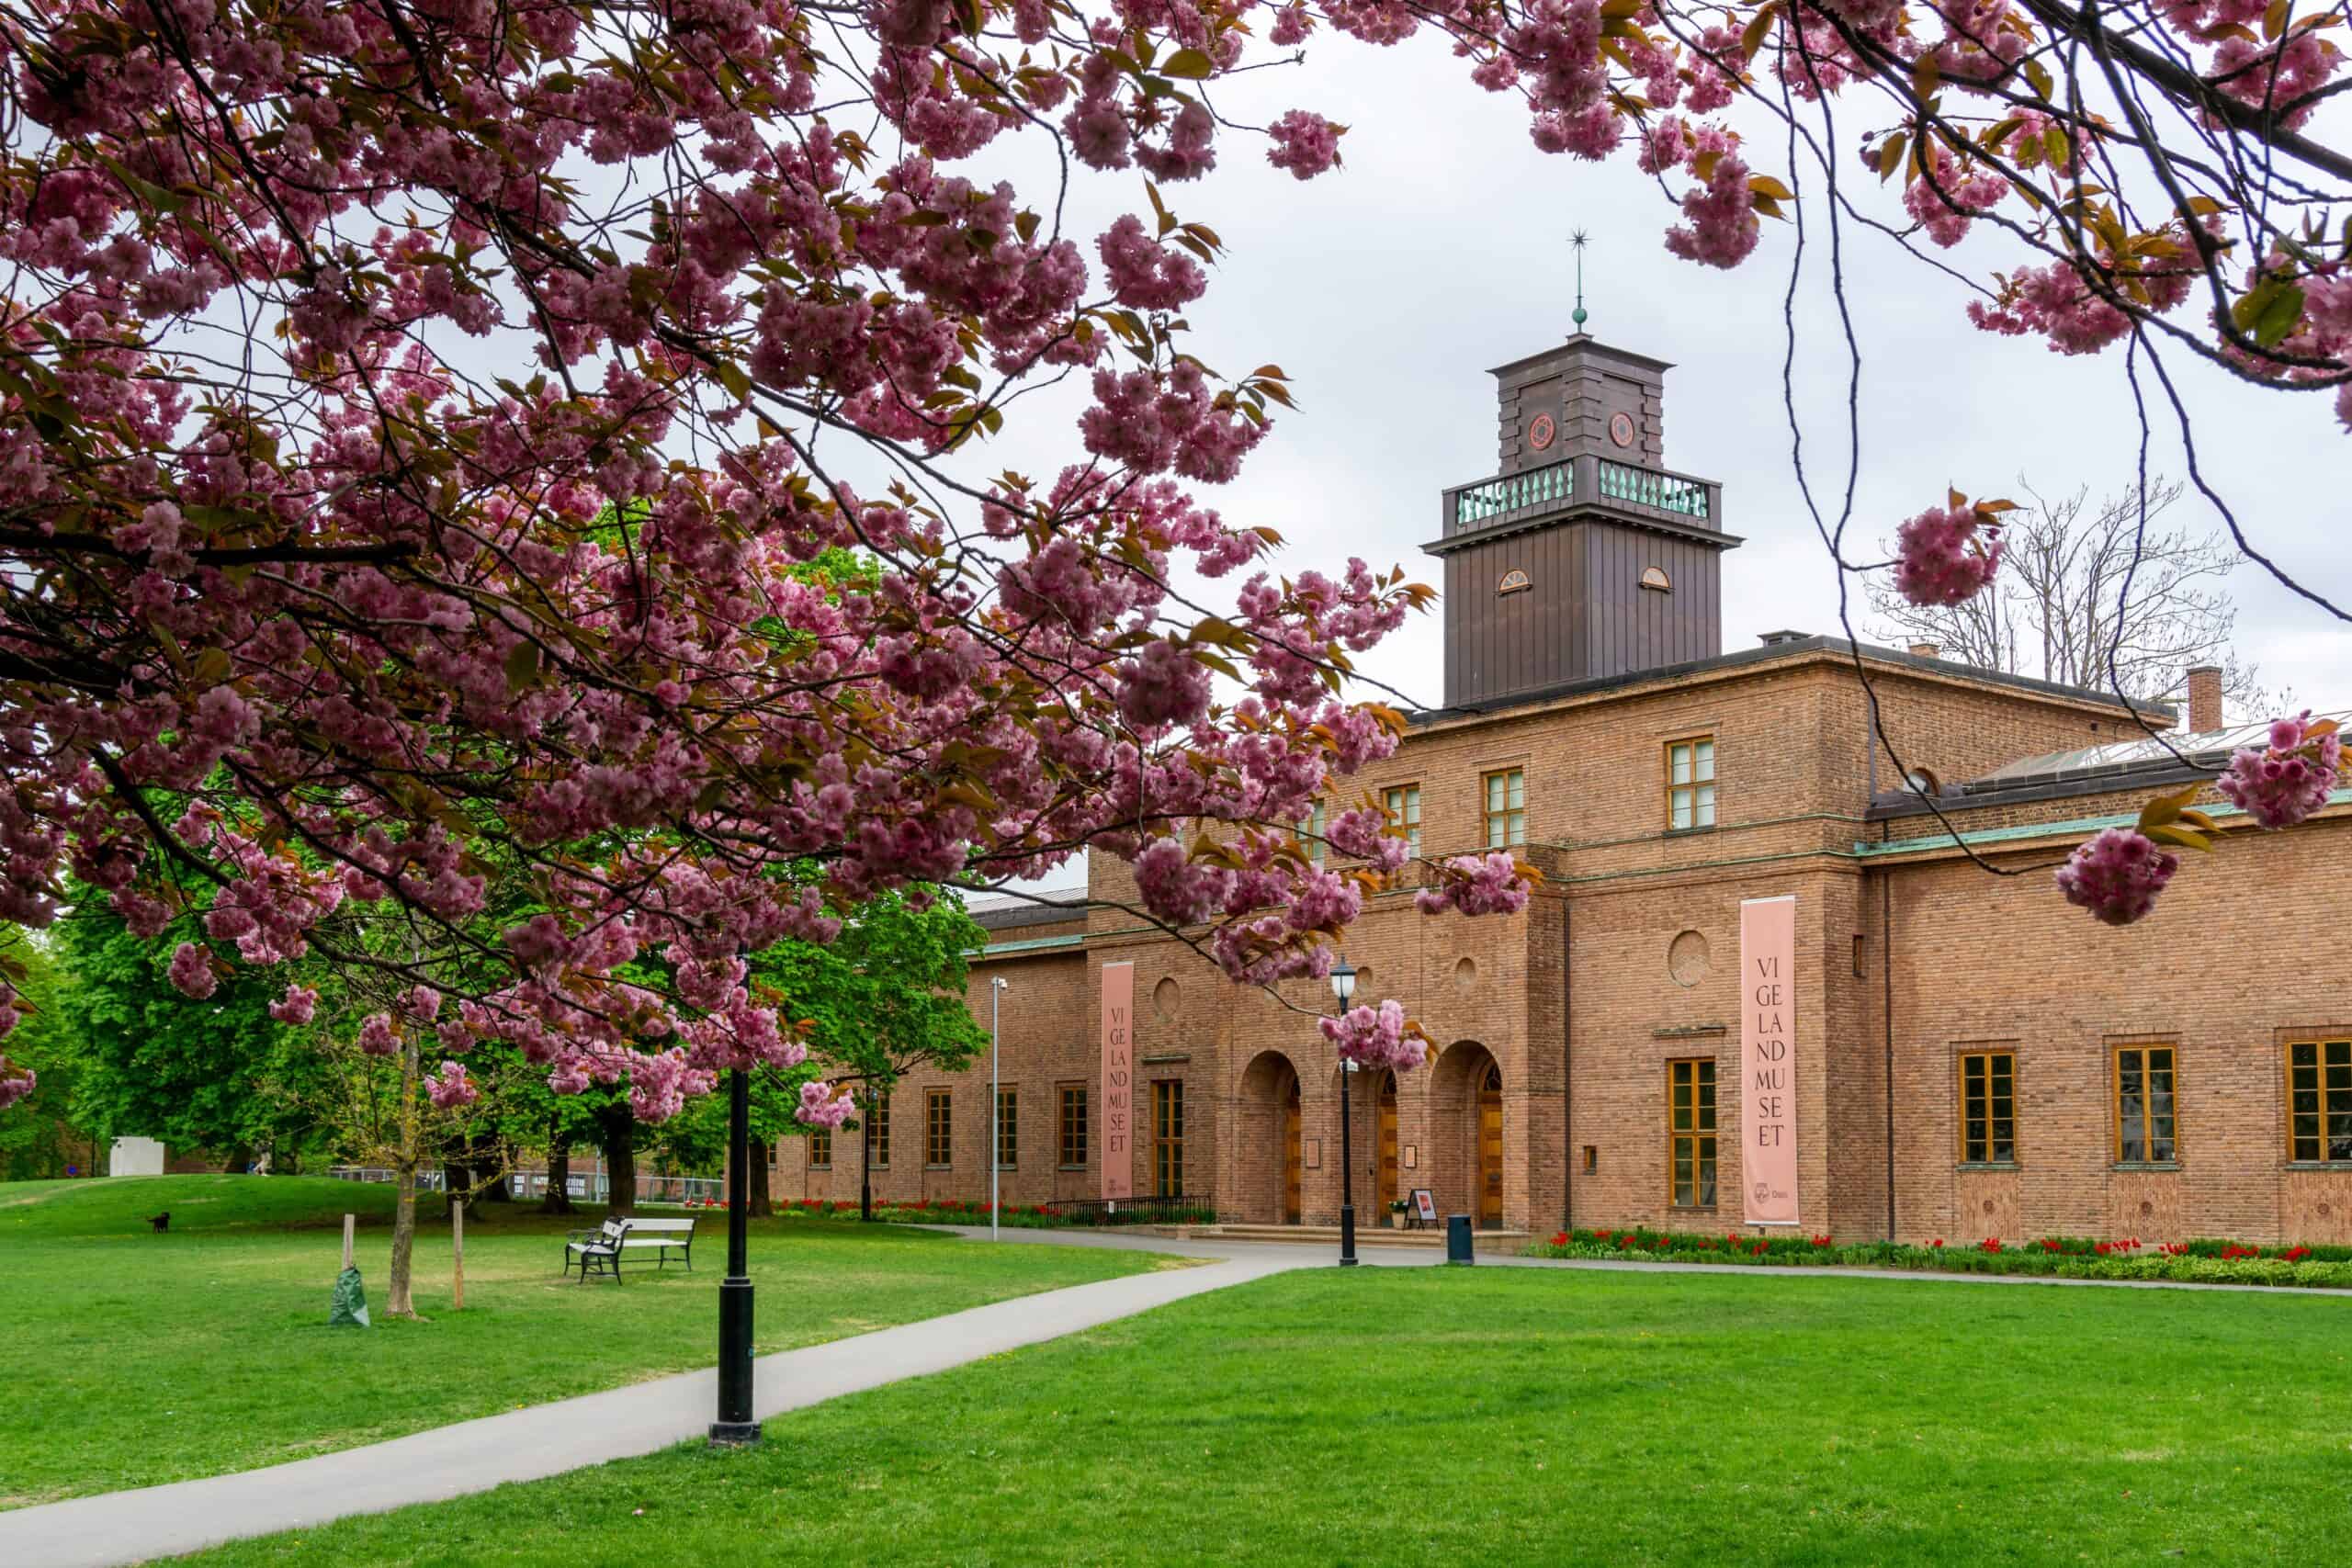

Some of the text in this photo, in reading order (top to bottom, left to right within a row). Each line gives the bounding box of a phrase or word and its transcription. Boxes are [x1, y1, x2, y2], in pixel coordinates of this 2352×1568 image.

[1757, 956, 1778, 978] VI
[1756, 984, 1783, 1007] GE
[1111, 1007, 1124, 1023] VI
[1758, 1012, 1782, 1034] LA
[1110, 1028, 1125, 1045] GE
[1111, 1050, 1125, 1066] LA
[1757, 1040, 1785, 1063] ND
[1109, 1071, 1127, 1088] ND
[1755, 1068, 1785, 1090] MU
[1108, 1093, 1127, 1110] MU
[1758, 1097, 1782, 1119] SE
[1110, 1114, 1125, 1131] SE
[1110, 1134, 1125, 1153] ET
[1758, 1124, 1784, 1146] ET
